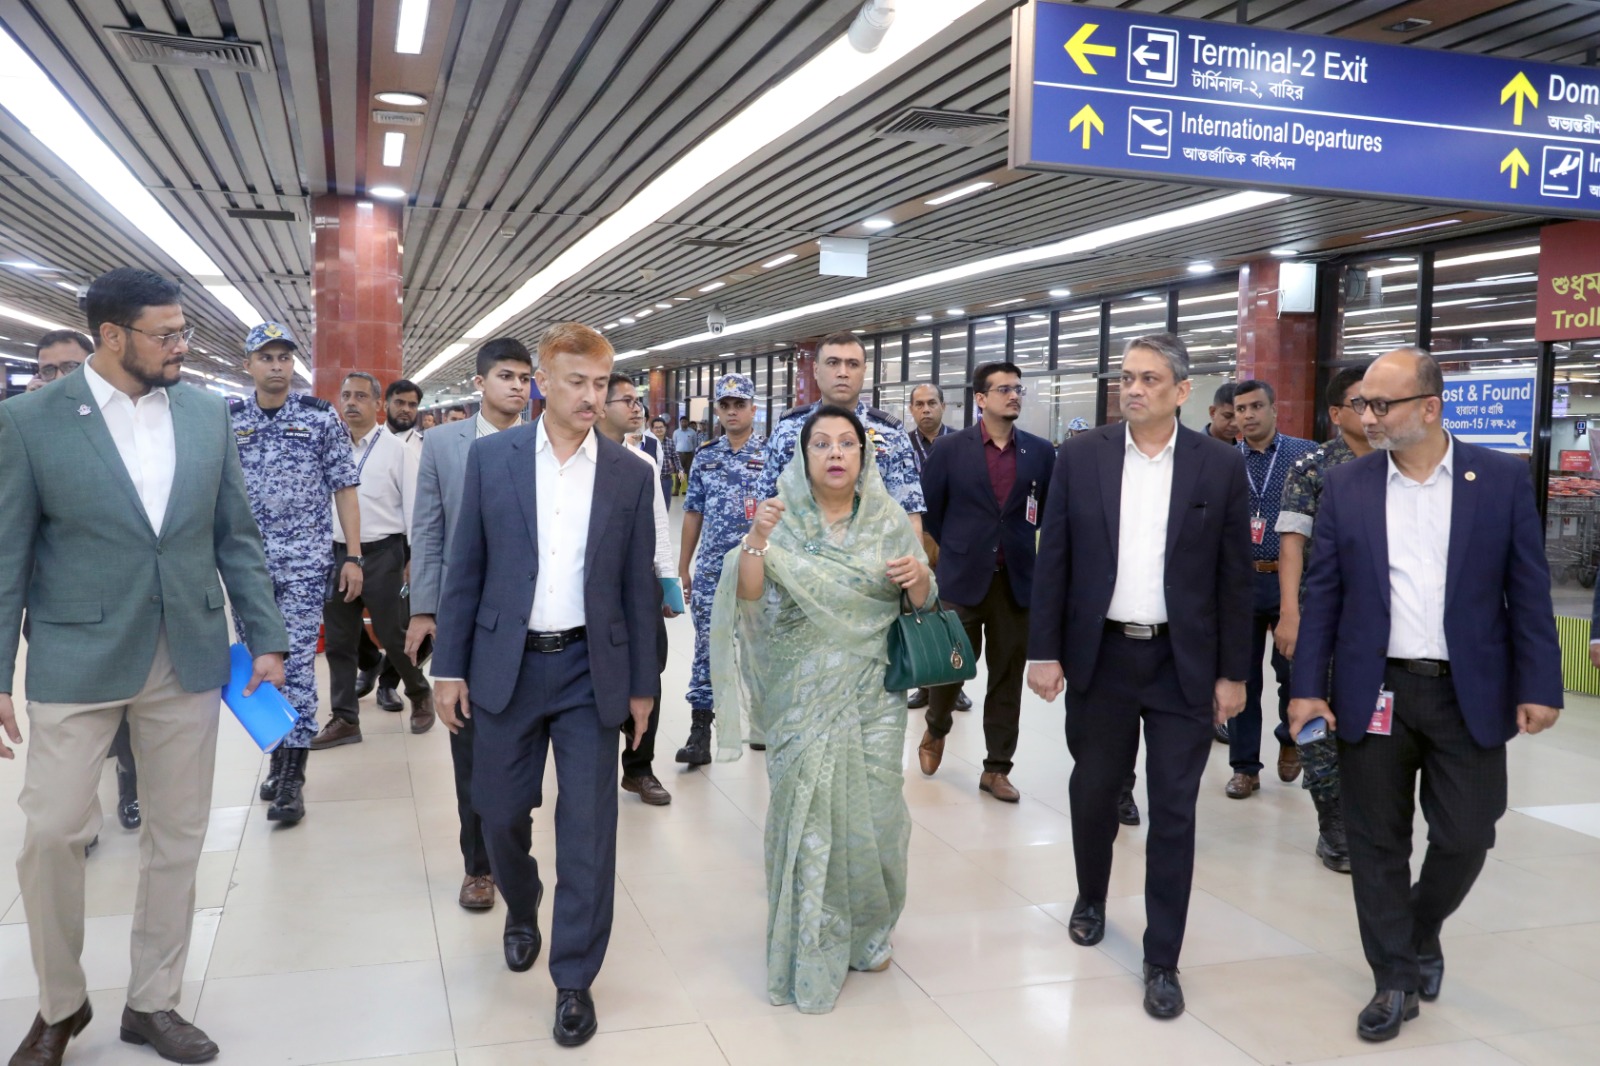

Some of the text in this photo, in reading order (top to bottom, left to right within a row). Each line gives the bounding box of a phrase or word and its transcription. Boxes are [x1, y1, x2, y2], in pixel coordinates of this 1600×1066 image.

[1188, 34, 1368, 84] Terminal-2 Exit
[1191, 69, 1304, 101] টার্মিনাল-২, বাহির
[1181, 111, 1383, 153] International Departures
[1183, 146, 1296, 171] আন্তর্জাতিক বহির্গমন
[1551, 307, 1600, 329] Troll
[1442, 382, 1531, 402] ost & Found
[1456, 405, 1478, 416] হারানো
[1480, 406, 1486, 414] ও
[1443, 418, 1483, 429] Room-15
[1485, 418, 1489, 429] /
